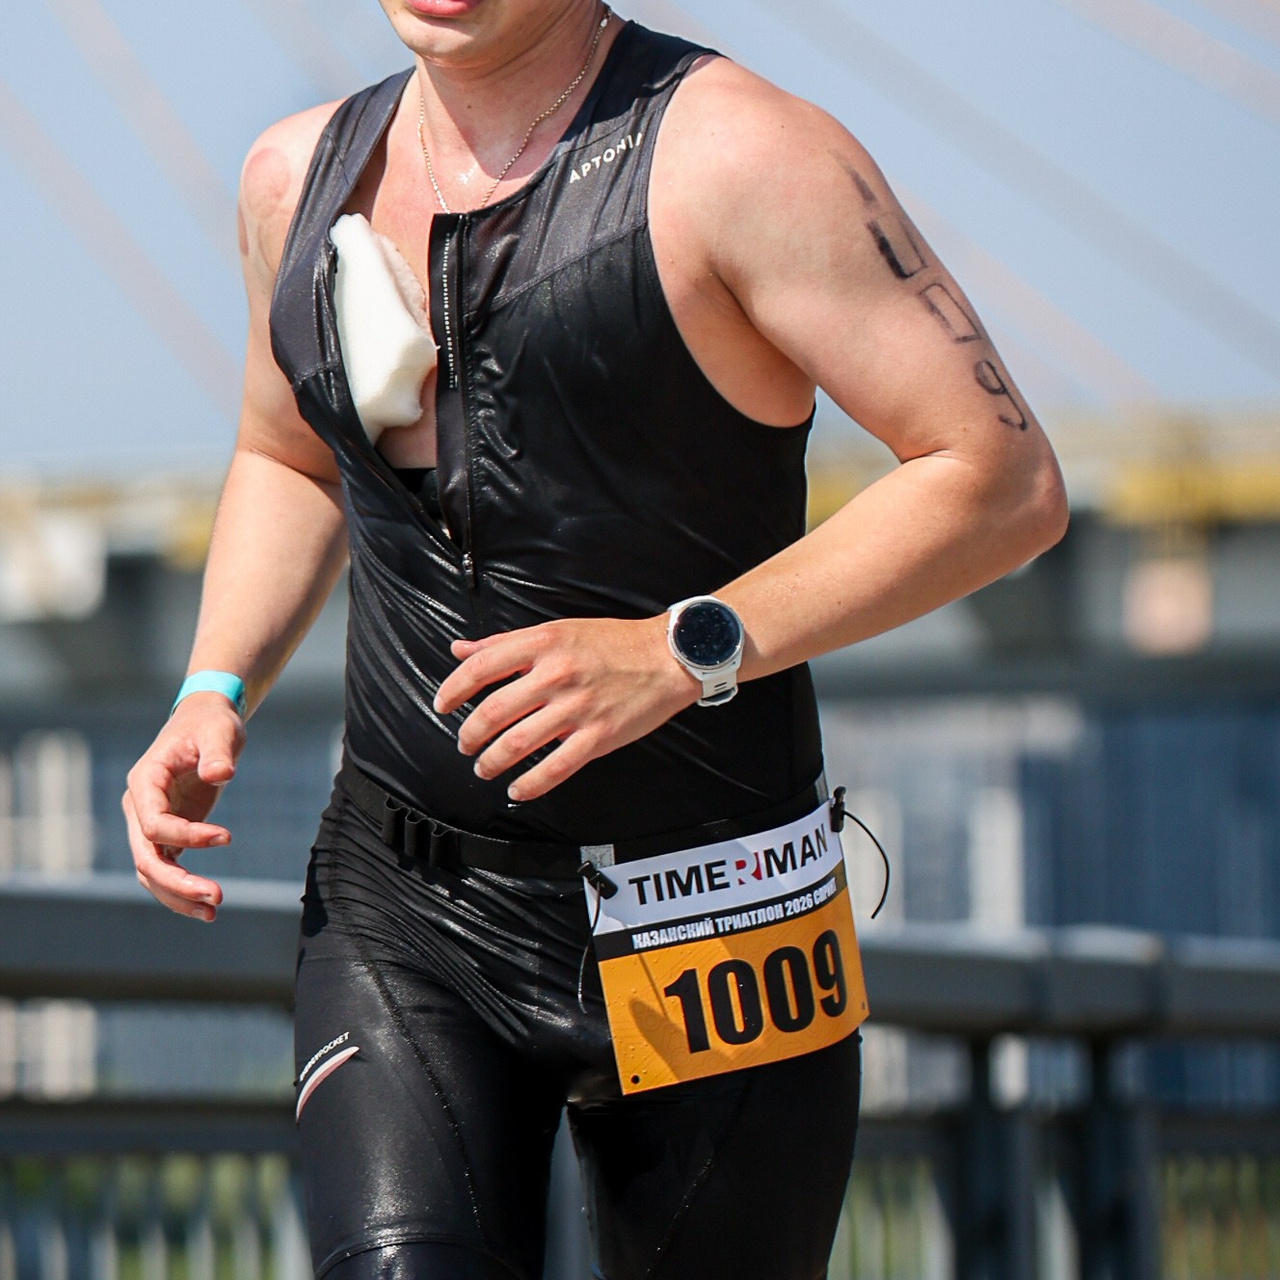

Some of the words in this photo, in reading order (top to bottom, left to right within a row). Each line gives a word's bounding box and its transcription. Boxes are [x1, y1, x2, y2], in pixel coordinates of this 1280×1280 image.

[631, 918, 715, 950] КАЗАНСКИЙ
[715, 902, 785, 933] ТРИАТЛОН
[785, 893, 813, 916] 2026
[664, 928, 848, 1054] 1009
